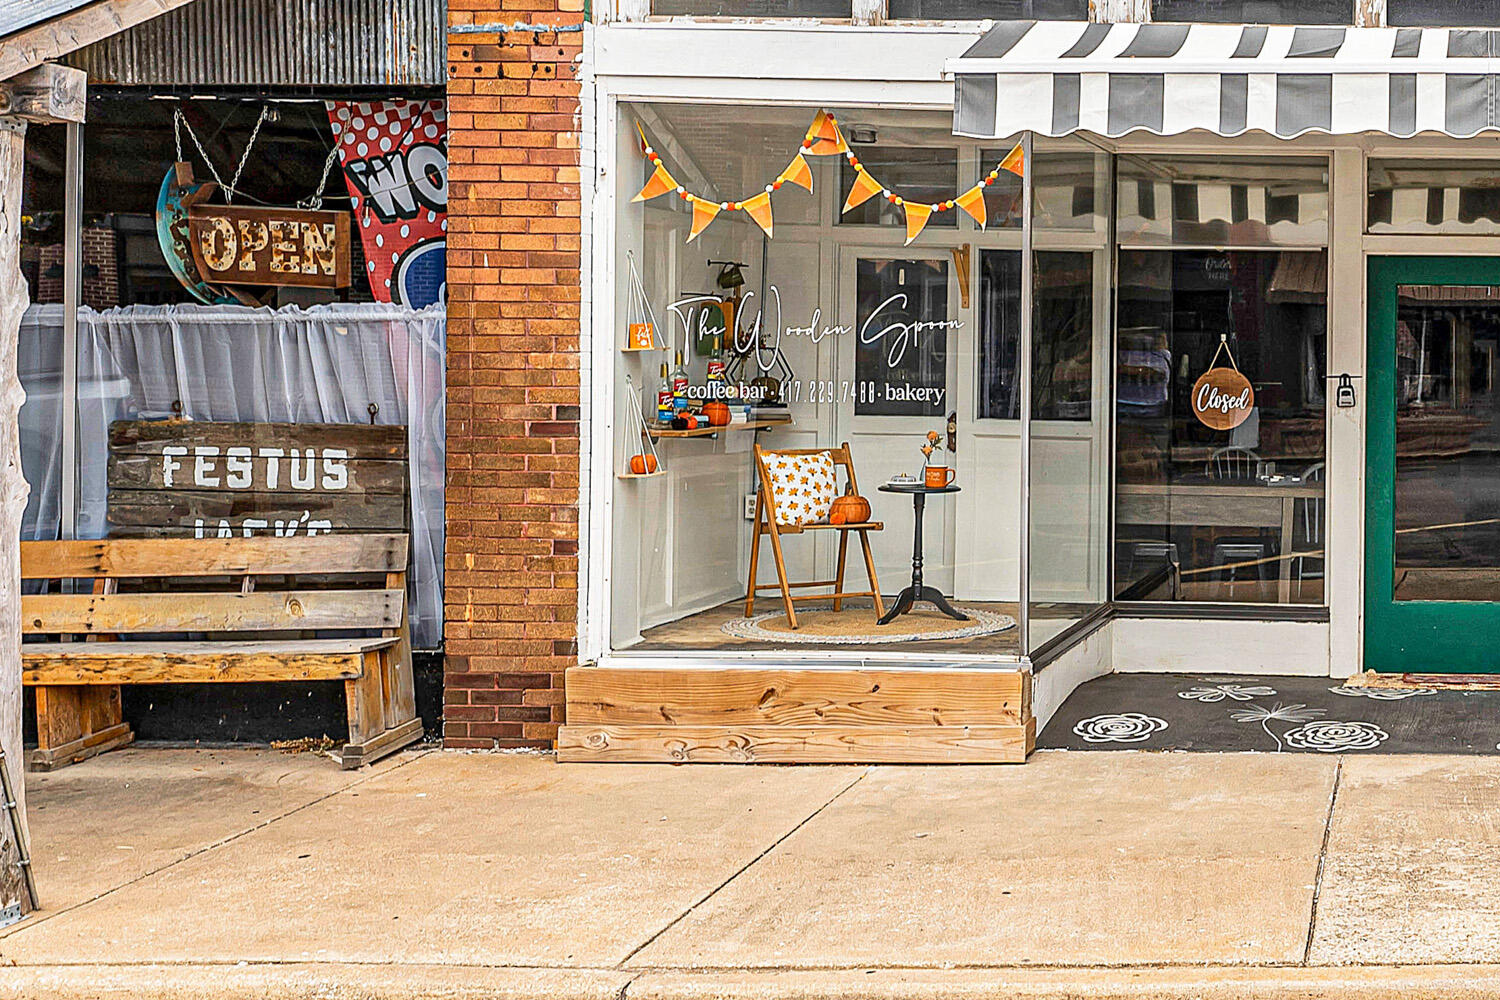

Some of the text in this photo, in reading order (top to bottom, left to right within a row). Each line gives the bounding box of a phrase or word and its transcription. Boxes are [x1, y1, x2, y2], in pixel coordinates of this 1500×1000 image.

[346, 138, 447, 221] WO
[201, 215, 337, 276] OPEN
[666, 285, 966, 371] The Wooden Spoon
[687, 380, 735, 399] coffee
[739, 381, 768, 399] bar
[778, 380, 875, 404] 417.229.7488
[885, 382, 946, 406] bakery
[1196, 383, 1250, 414] Closed
[161, 446, 349, 490] FESTUS
